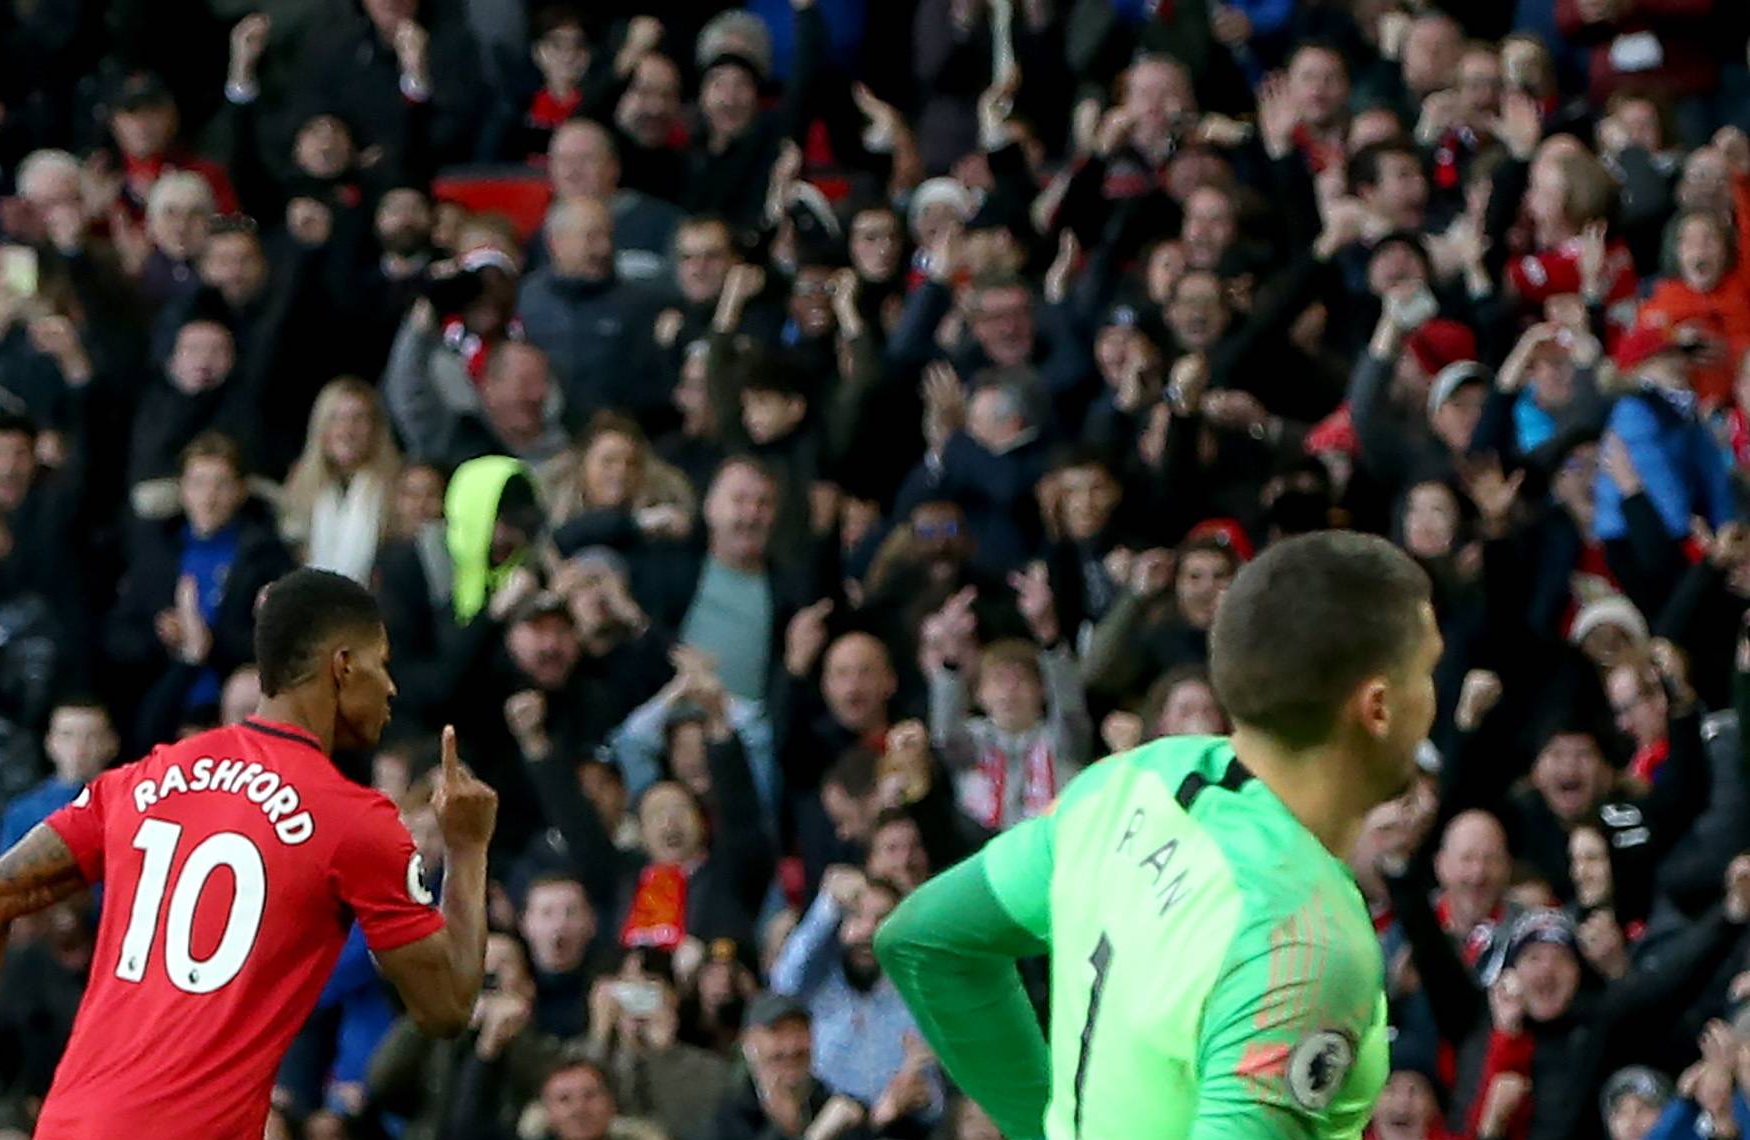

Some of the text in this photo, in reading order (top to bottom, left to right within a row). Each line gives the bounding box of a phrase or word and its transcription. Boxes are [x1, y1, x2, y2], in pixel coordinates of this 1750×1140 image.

[133, 757, 315, 845] RASHFORD
[114, 816, 268, 995] 10
[1116, 807, 1192, 917] RAN
